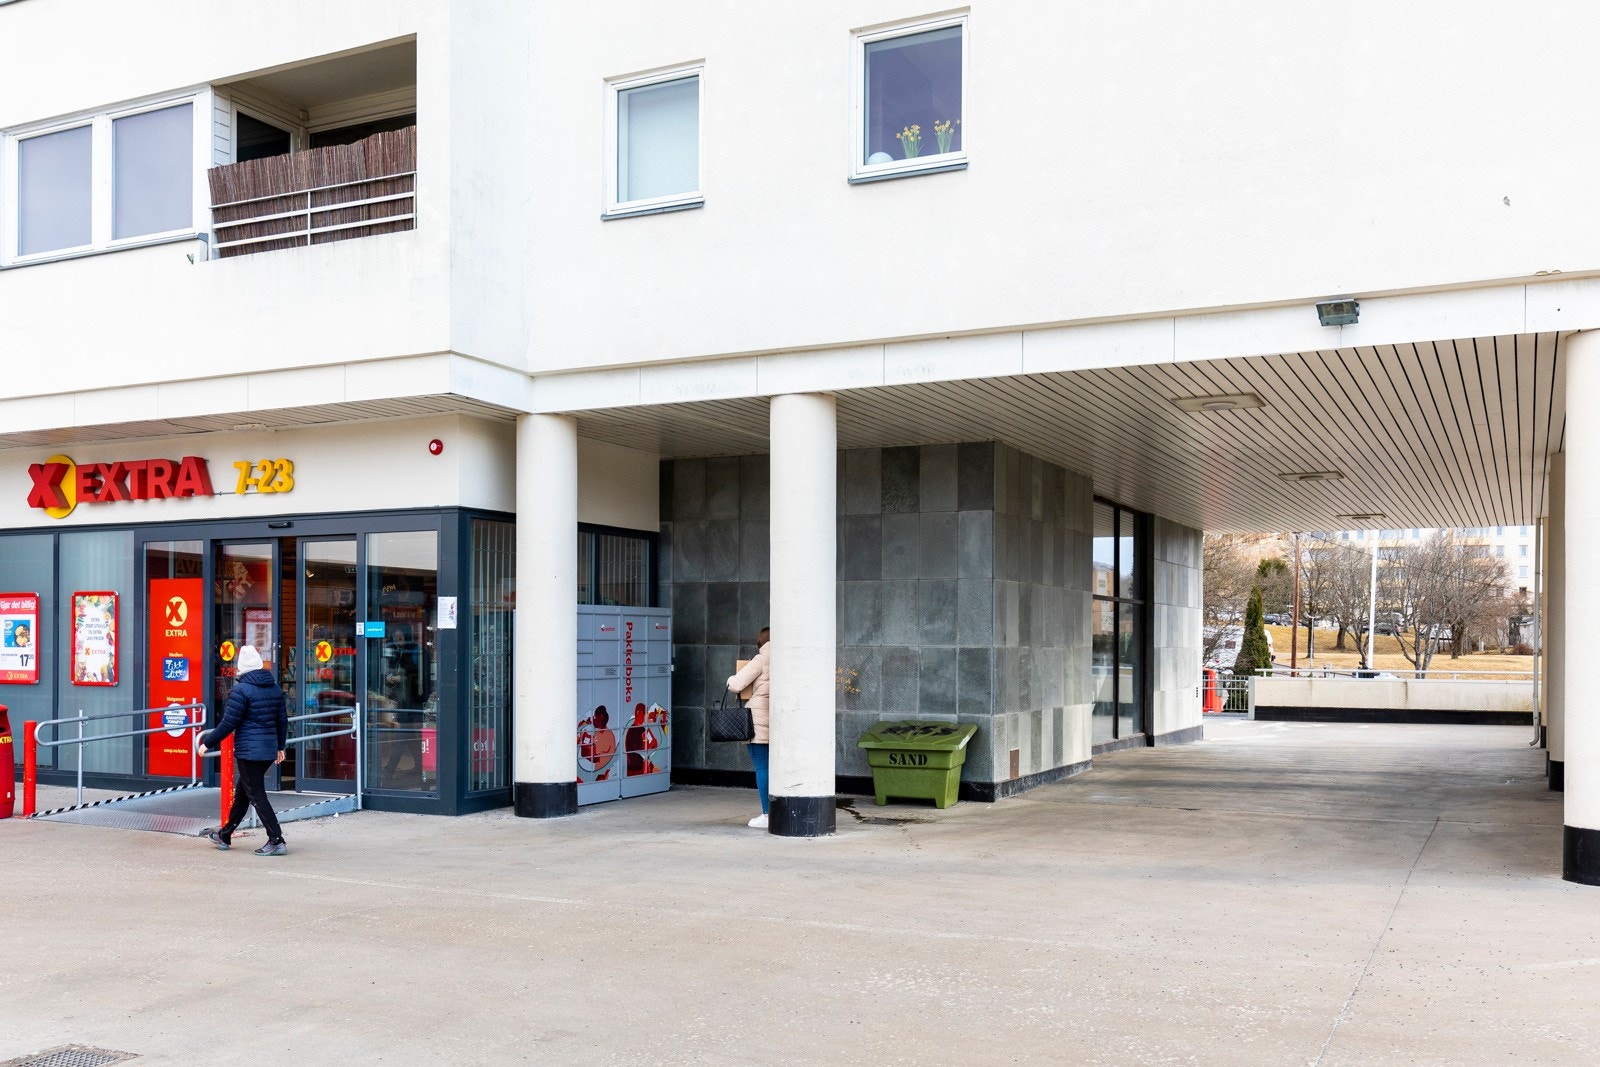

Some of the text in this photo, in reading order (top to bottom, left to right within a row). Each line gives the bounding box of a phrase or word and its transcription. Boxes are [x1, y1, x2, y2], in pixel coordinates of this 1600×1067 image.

[76, 456, 214, 503] EXTRA
[233, 458, 295, 495] 7-23
[333, 647, 357, 656] EXTRA
[20, 654, 29, 667] 17
[625, 621, 633, 703] Pakkeboks
[889, 753, 928, 766] SAND
